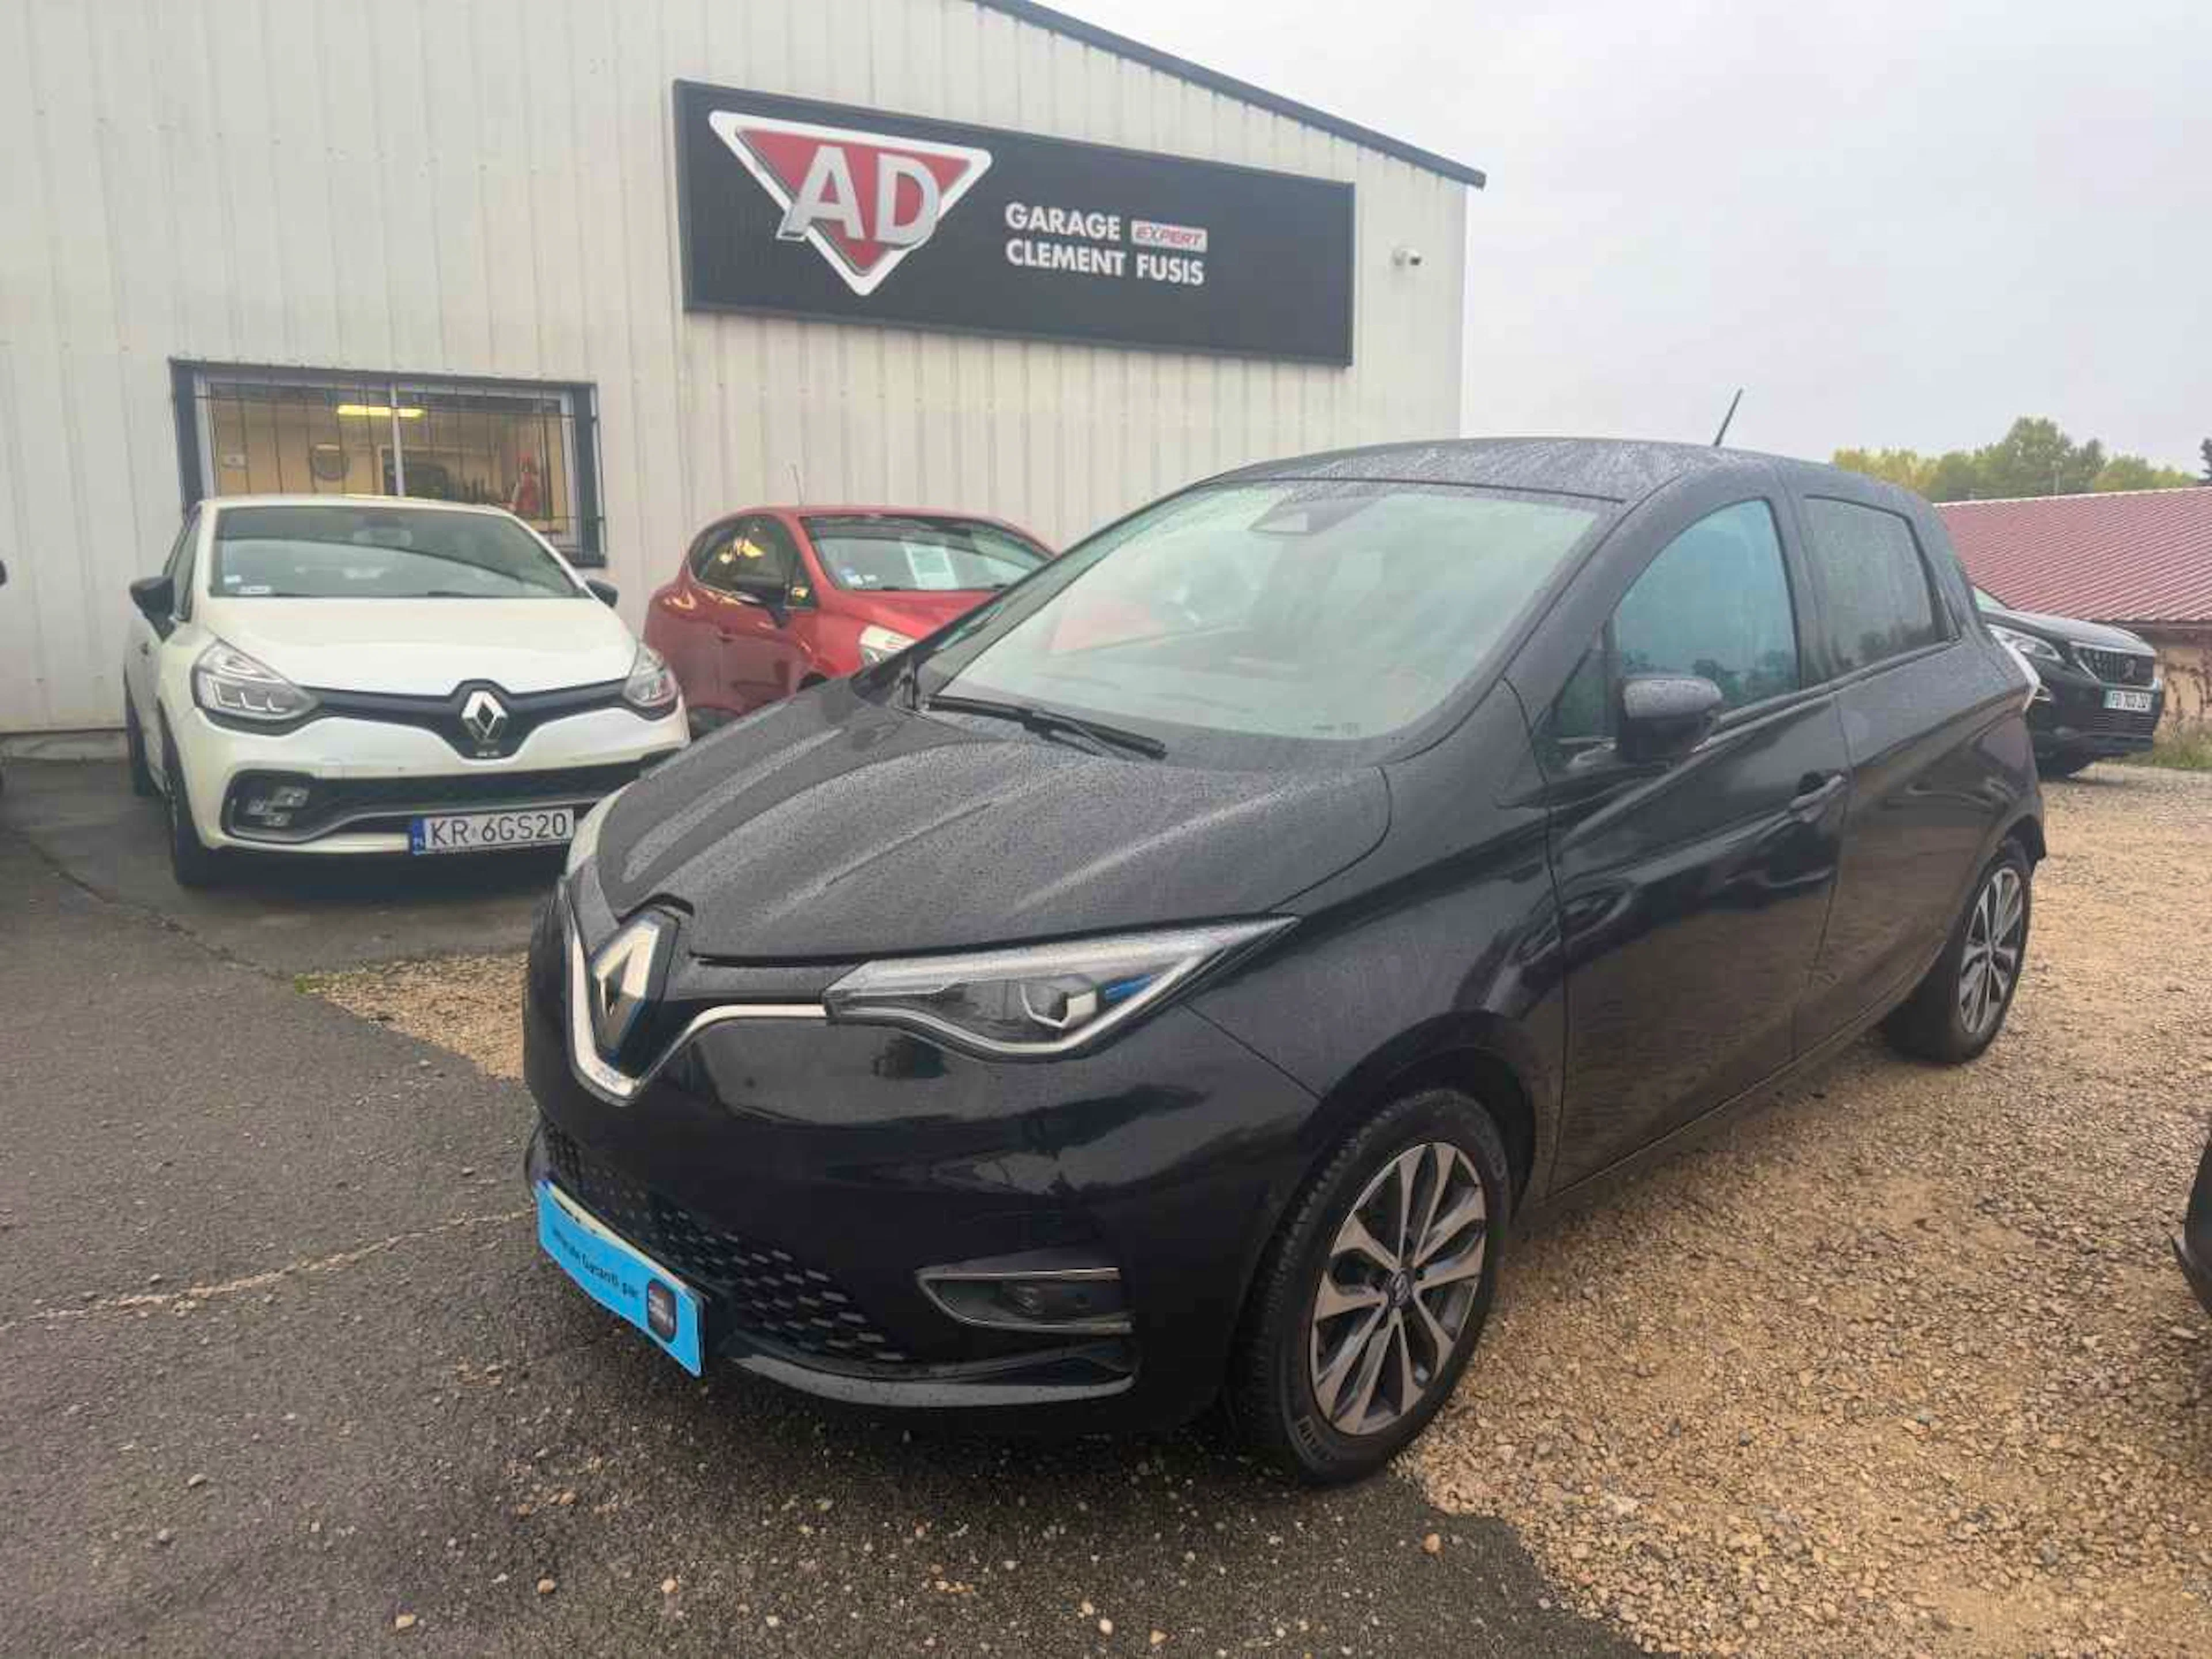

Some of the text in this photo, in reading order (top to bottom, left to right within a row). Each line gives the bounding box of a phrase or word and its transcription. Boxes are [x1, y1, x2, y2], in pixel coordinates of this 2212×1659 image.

[776, 145, 940, 245] AD
[1005, 202, 1204, 247] GARAGE EXPERT
[1006, 238, 1205, 286] CLEMENT FUSIS
[430, 819, 469, 845] KR
[482, 812, 567, 843] 6GS20
